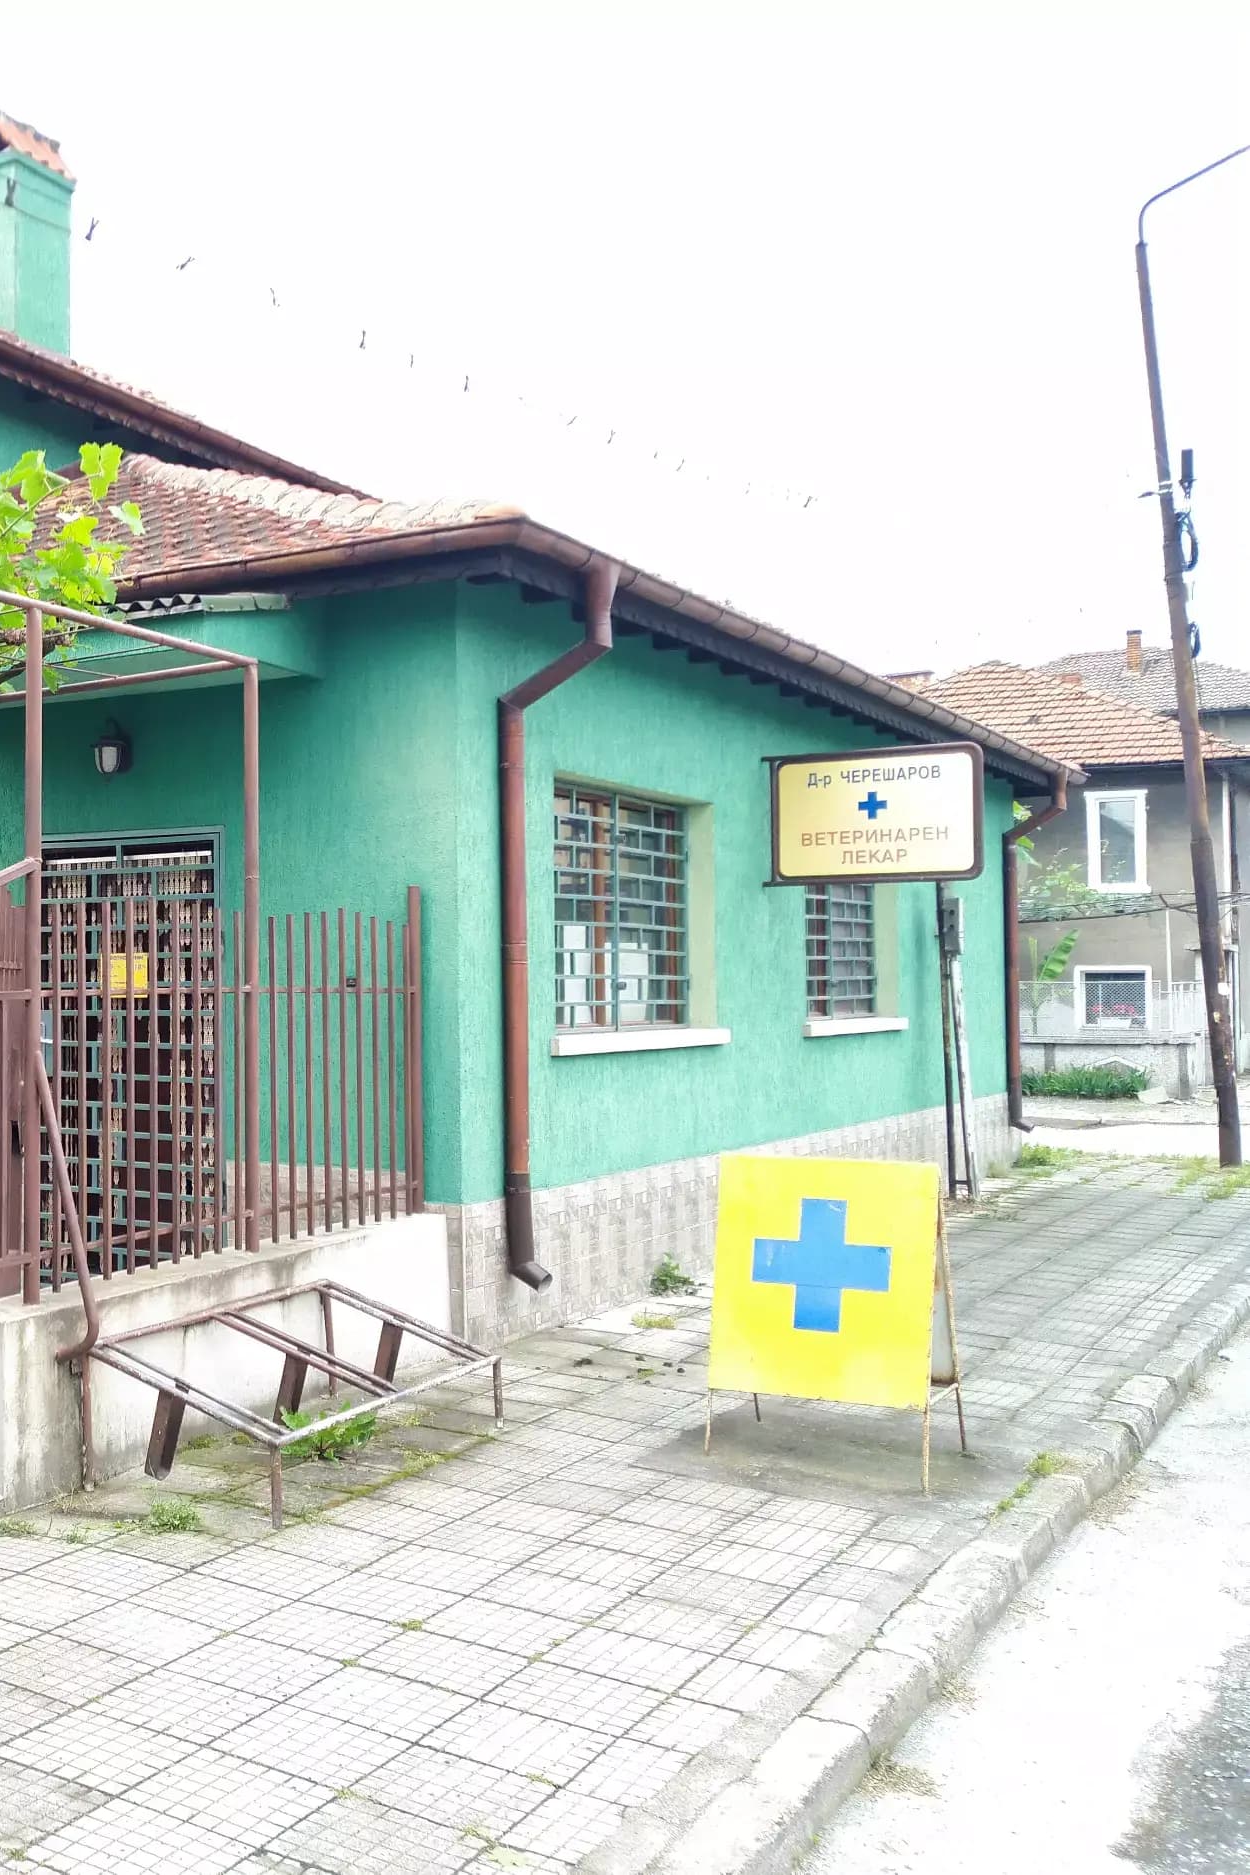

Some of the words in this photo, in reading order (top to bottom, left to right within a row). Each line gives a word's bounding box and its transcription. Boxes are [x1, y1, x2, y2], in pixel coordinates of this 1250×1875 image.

[807, 772, 832, 788] Д-р
[840, 765, 941, 784] ЧЕРЕШАРОВ
[801, 826, 949, 847] ВЕТЕРИНАРЕН
[841, 848, 908, 865] ЛЕКАР
